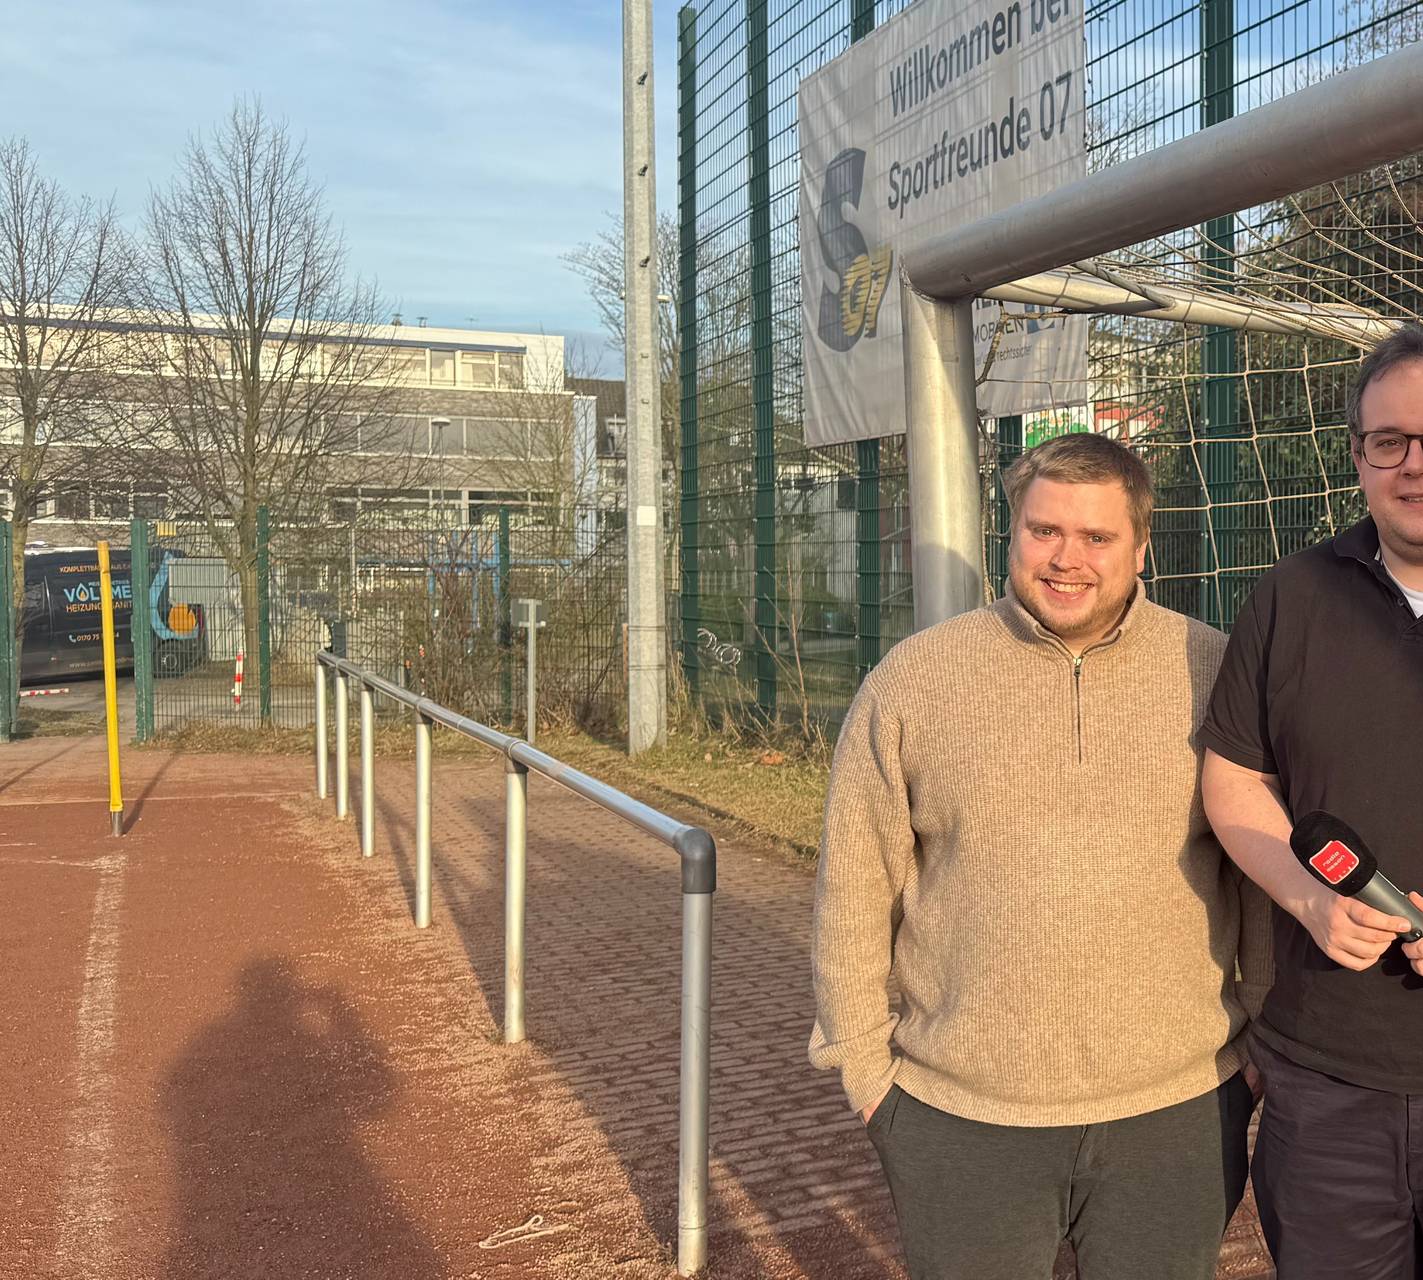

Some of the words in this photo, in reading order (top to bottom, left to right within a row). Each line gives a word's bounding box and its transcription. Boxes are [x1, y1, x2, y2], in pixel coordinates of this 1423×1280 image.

[890, 2, 1022, 117] Willkommen
[888, 97, 1031, 219] Sportfreunde
[1040, 71, 1072, 141] 07
